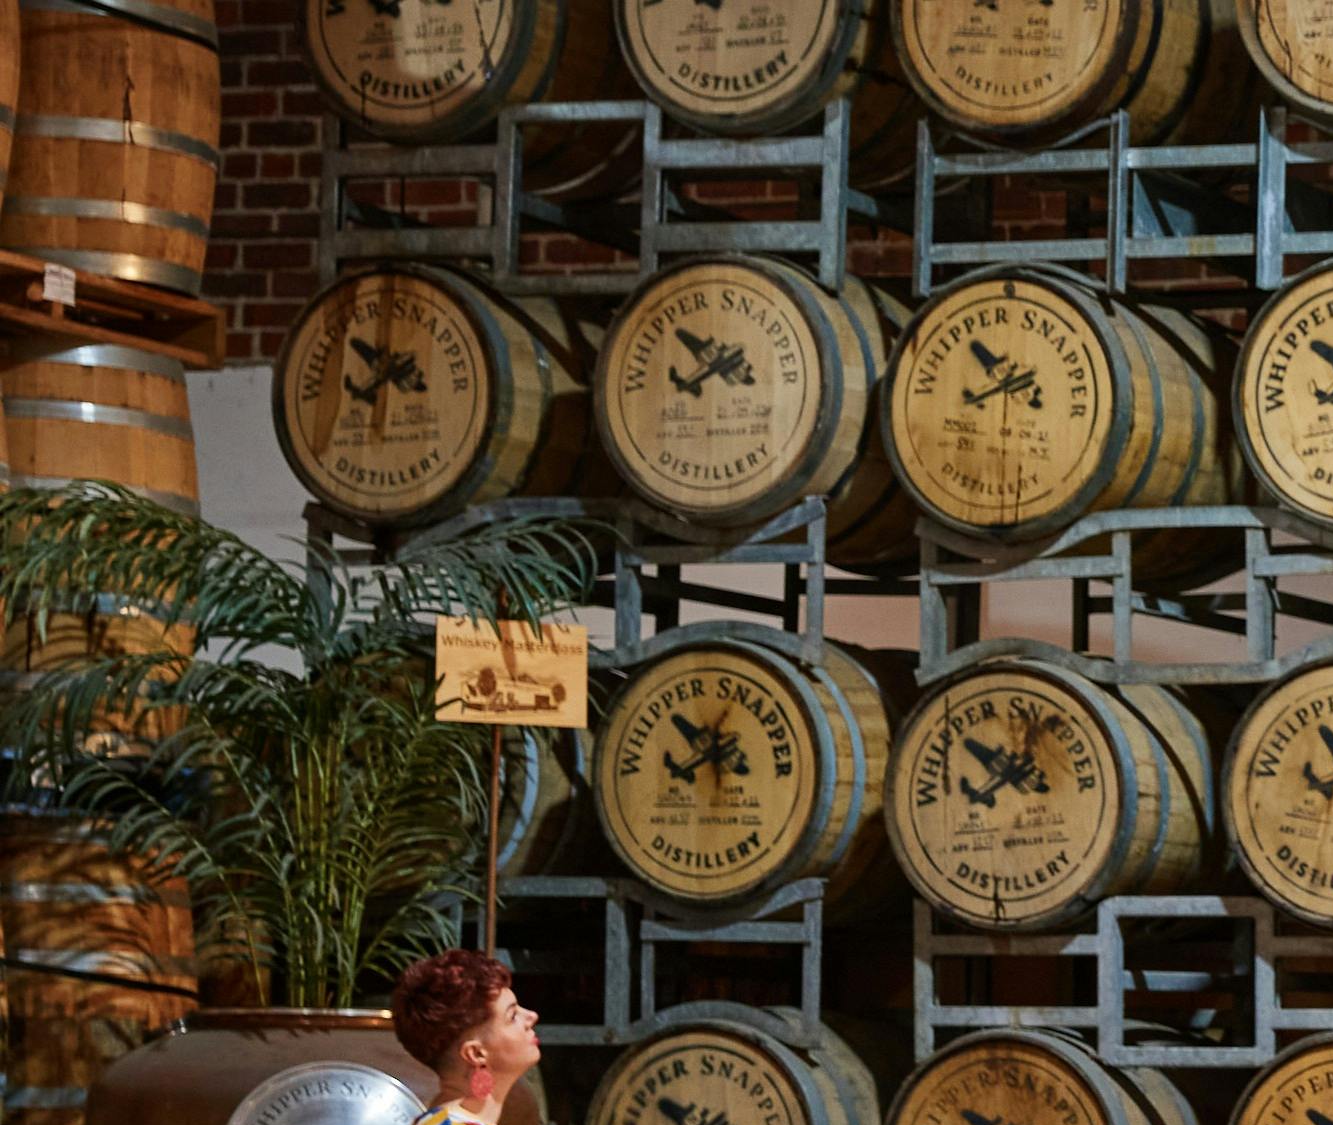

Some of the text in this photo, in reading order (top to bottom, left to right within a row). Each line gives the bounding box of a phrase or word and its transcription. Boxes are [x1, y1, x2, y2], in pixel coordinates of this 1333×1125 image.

[360, 61, 466, 92] DISTILLERY
[678, 51, 789, 91] DISTILLERY
[956, 73, 1054, 98] DISTILLERY
[302, 297, 470, 402] WHIPPER SNAPPER
[624, 288, 800, 393] WHIPPER SNAPPER
[914, 308, 1086, 418] WHIPPER SNAPPER
[336, 448, 442, 487] DISTILLERY
[659, 442, 769, 481] DISTILLERY
[941, 462, 1040, 495] DISTILLERY
[441, 634, 497, 652] Whiskey
[620, 676, 794, 779] WHIPPER SNAPPER
[652, 832, 761, 869] DISTILLERY
[957, 850, 1070, 892] DISTILLERY
